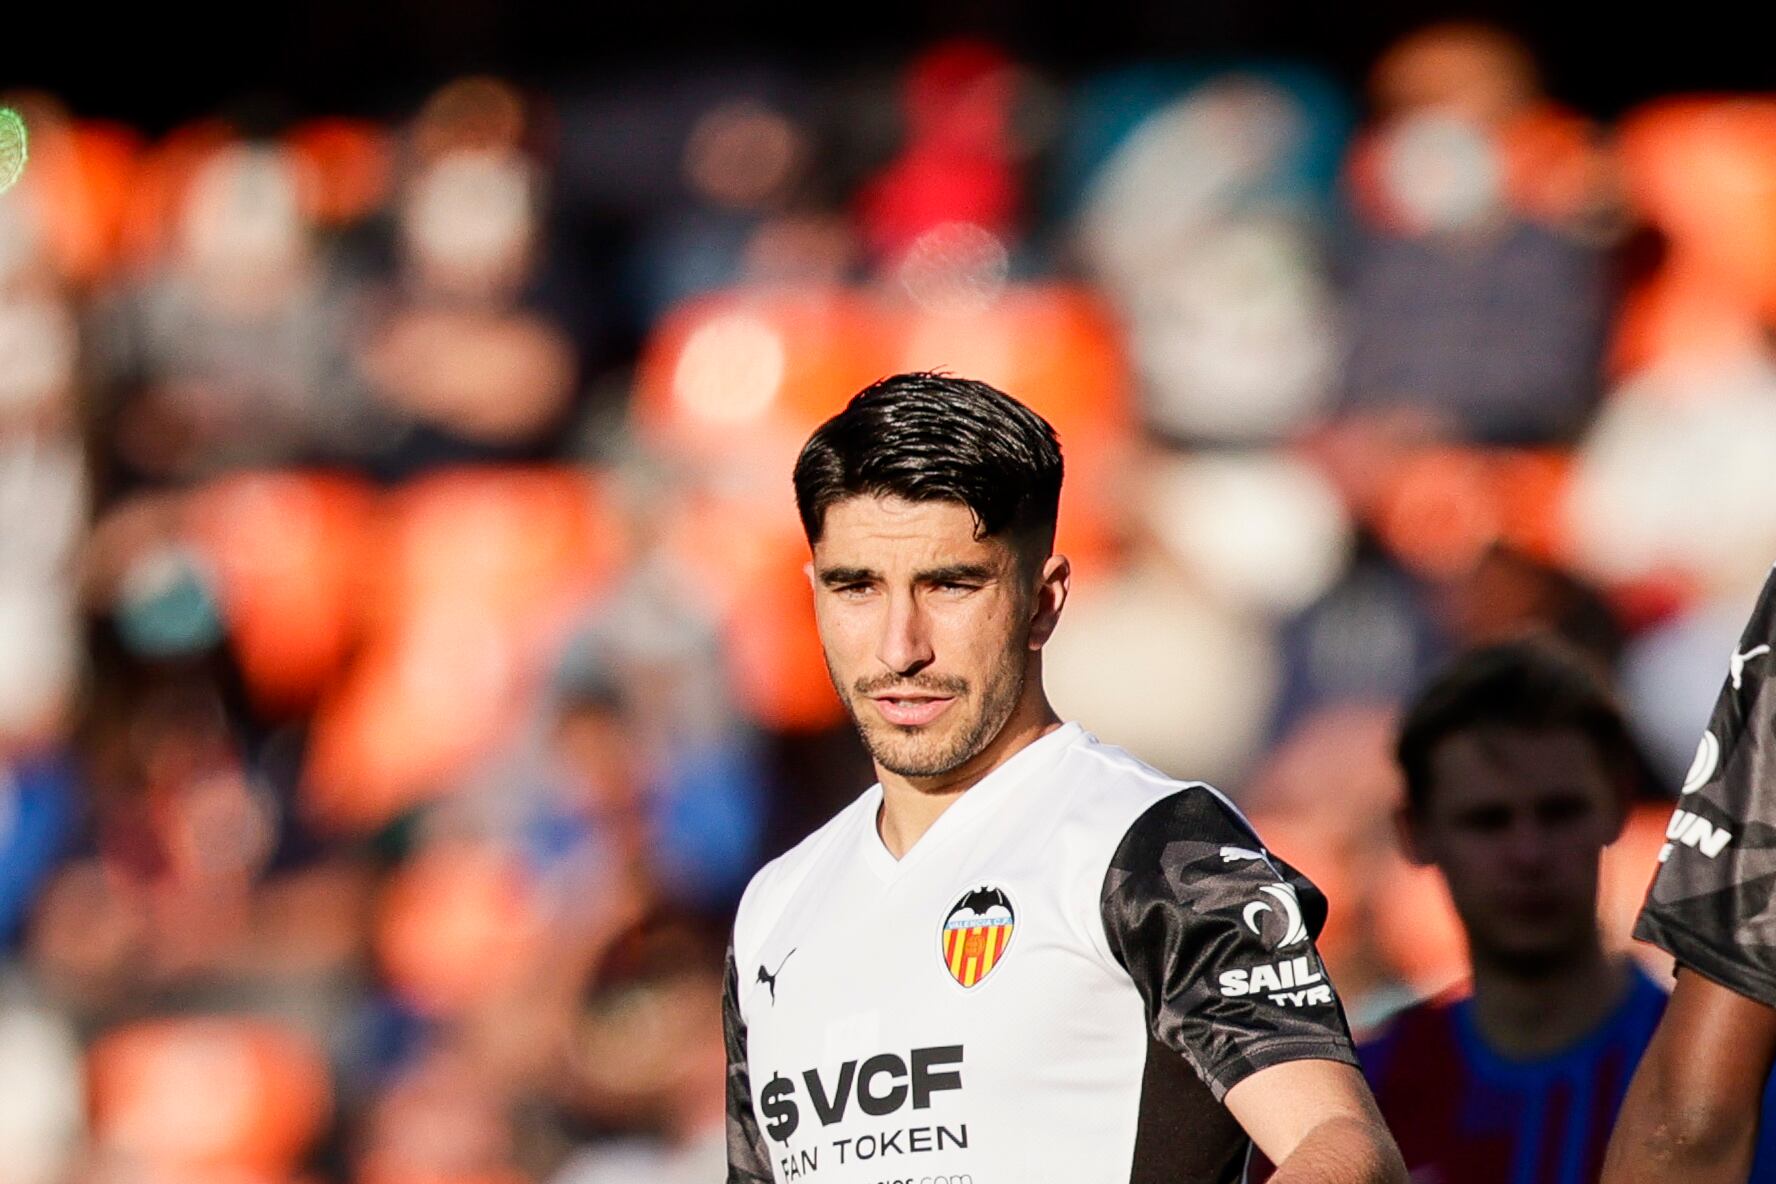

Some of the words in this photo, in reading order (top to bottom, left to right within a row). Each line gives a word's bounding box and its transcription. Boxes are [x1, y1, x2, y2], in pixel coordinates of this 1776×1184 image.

[760, 1044, 964, 1148] $VCF
[781, 1146, 818, 1184] FAN
[832, 1124, 968, 1164] TOKEN
